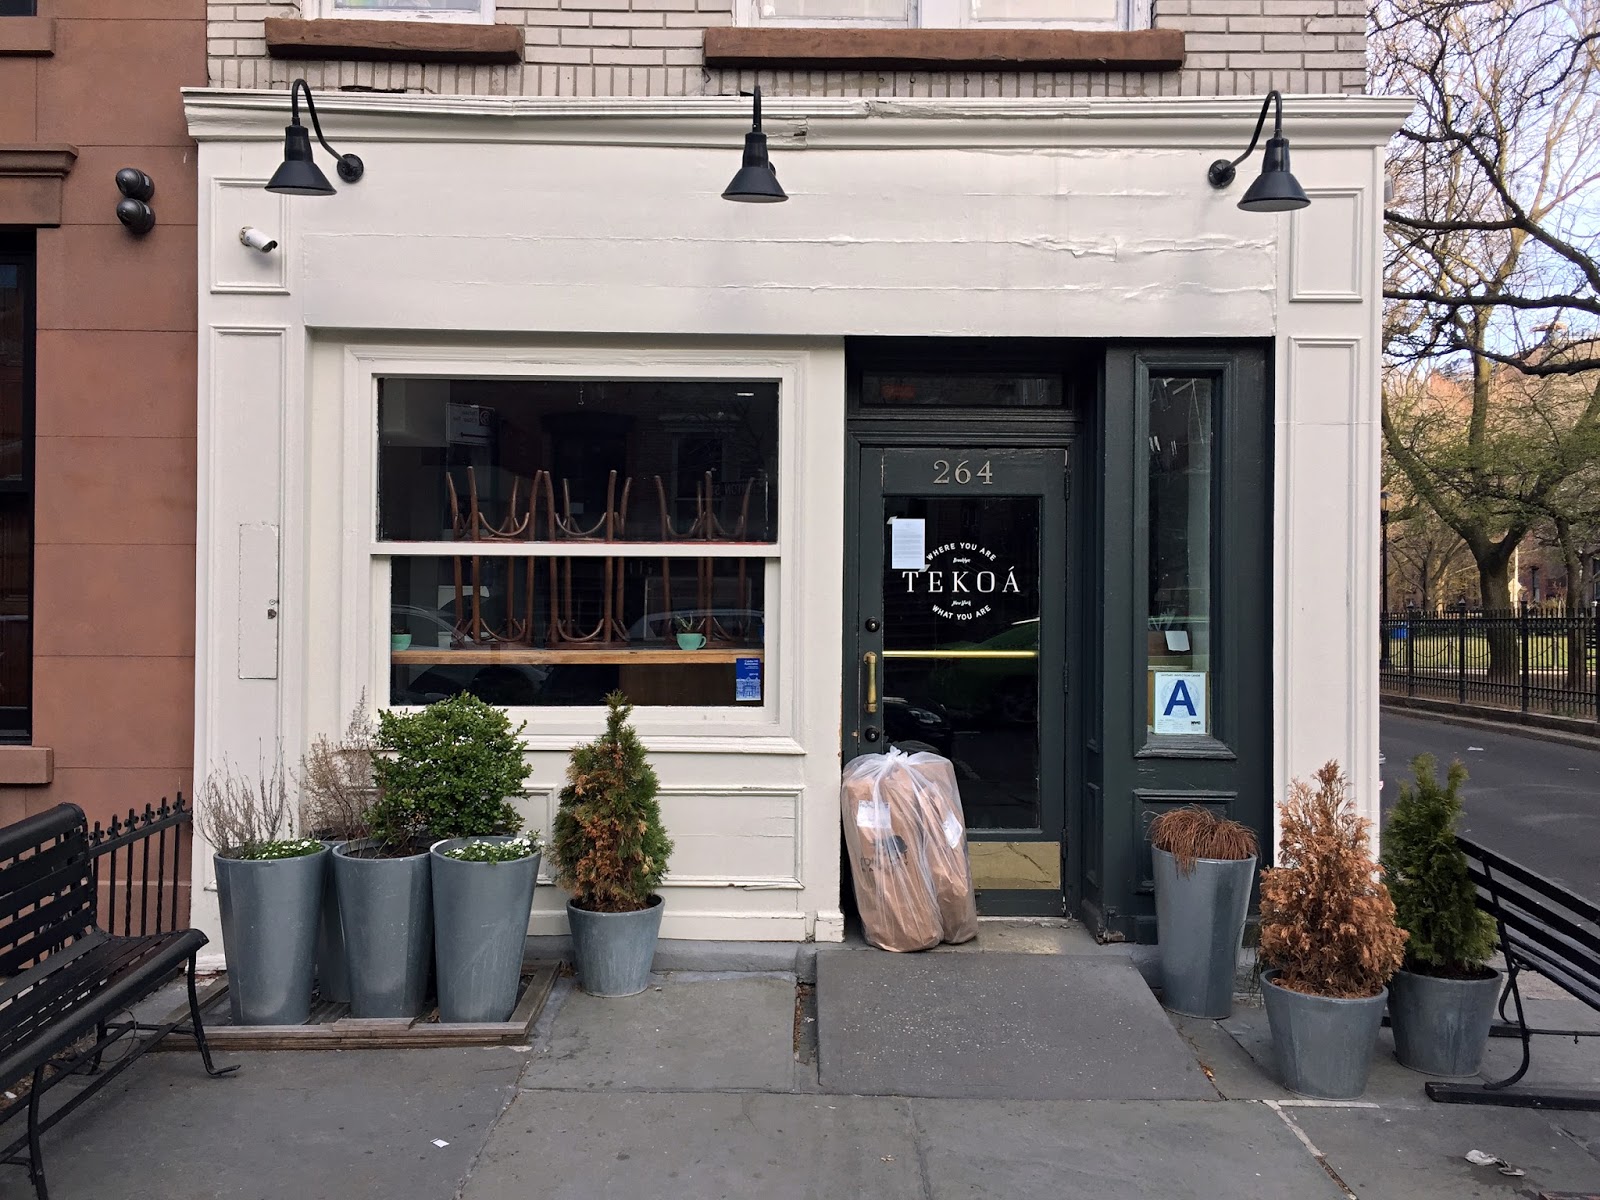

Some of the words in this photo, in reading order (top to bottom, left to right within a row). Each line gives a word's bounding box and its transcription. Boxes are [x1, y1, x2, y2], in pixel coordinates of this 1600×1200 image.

[933, 460, 993, 485] 264
[926, 543, 956, 561] WHERE
[960, 542, 978, 551] YOU
[979, 547, 997, 562] ARE
[902, 566, 1021, 593] TEKOÁ
[932, 605, 954, 619] WHAT
[956, 613, 973, 621] YOU
[976, 605, 992, 618] ARE
[1163, 680, 1197, 716] A
